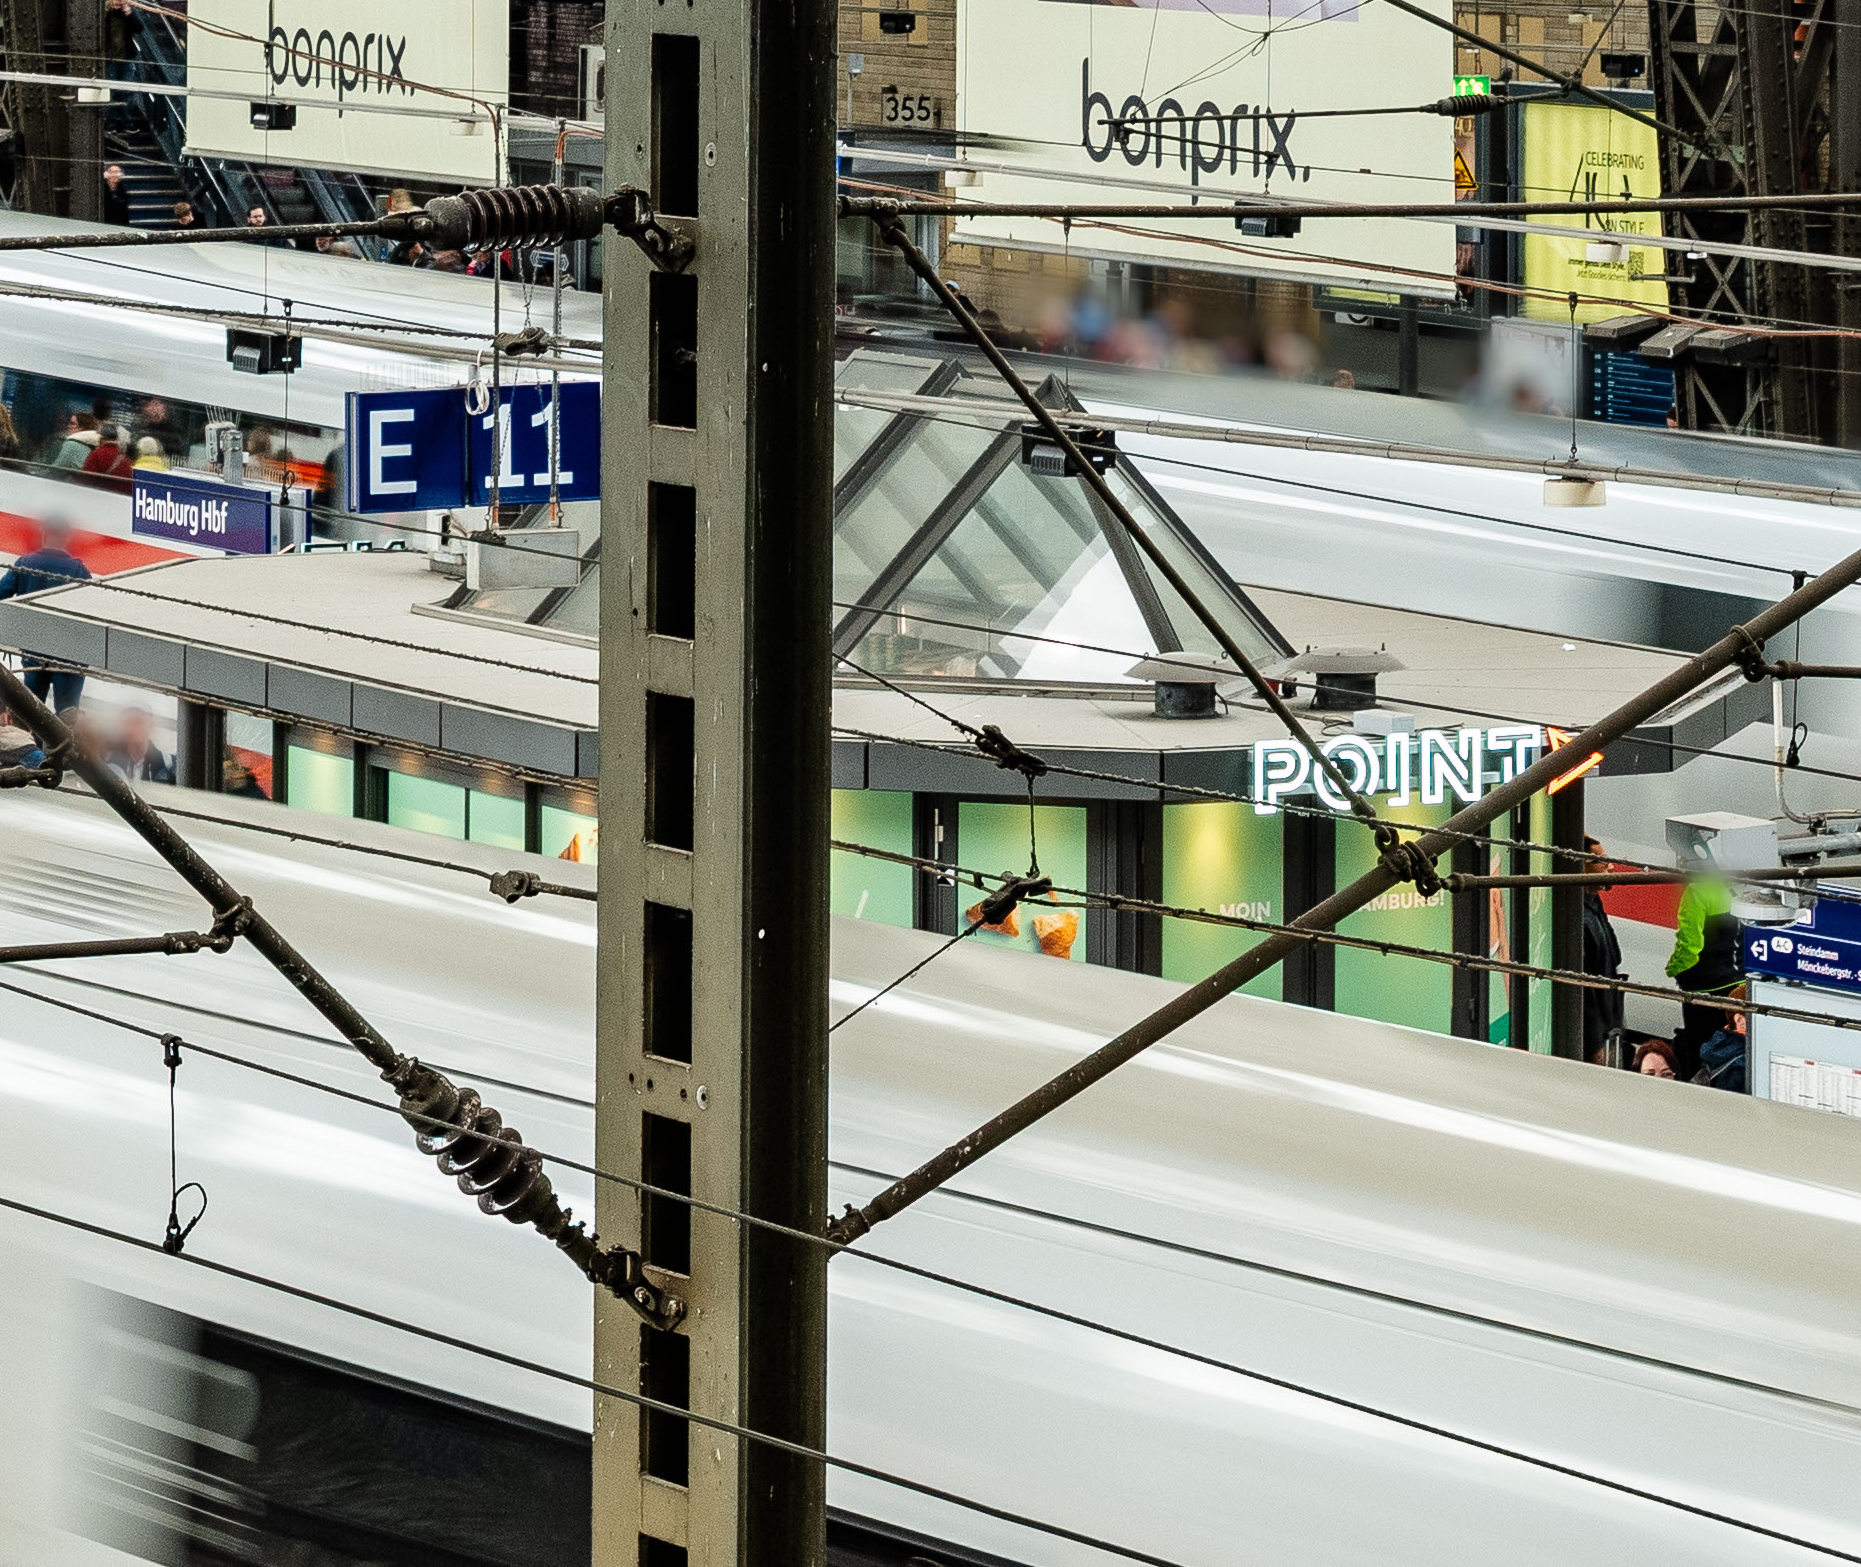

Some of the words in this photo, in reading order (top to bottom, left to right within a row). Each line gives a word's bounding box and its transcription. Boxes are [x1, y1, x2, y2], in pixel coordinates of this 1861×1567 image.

[885, 95, 932, 122] 355
[1082, 57, 1311, 206] bonprix.
[1585, 151, 1645, 171] CELEBRATING
[369, 408, 418, 496] E
[482, 400, 574, 490] 11
[135, 487, 199, 536] Hamburg
[201, 495, 228, 534] Hbf
[1252, 725, 1543, 816] POINT
[1219, 900, 1272, 922] MOIN
[1356, 890, 1445, 913] AMBURG!
[1797, 943, 1839, 961] Steindamm
[1797, 959, 1854, 981] Mönckebergstr.
